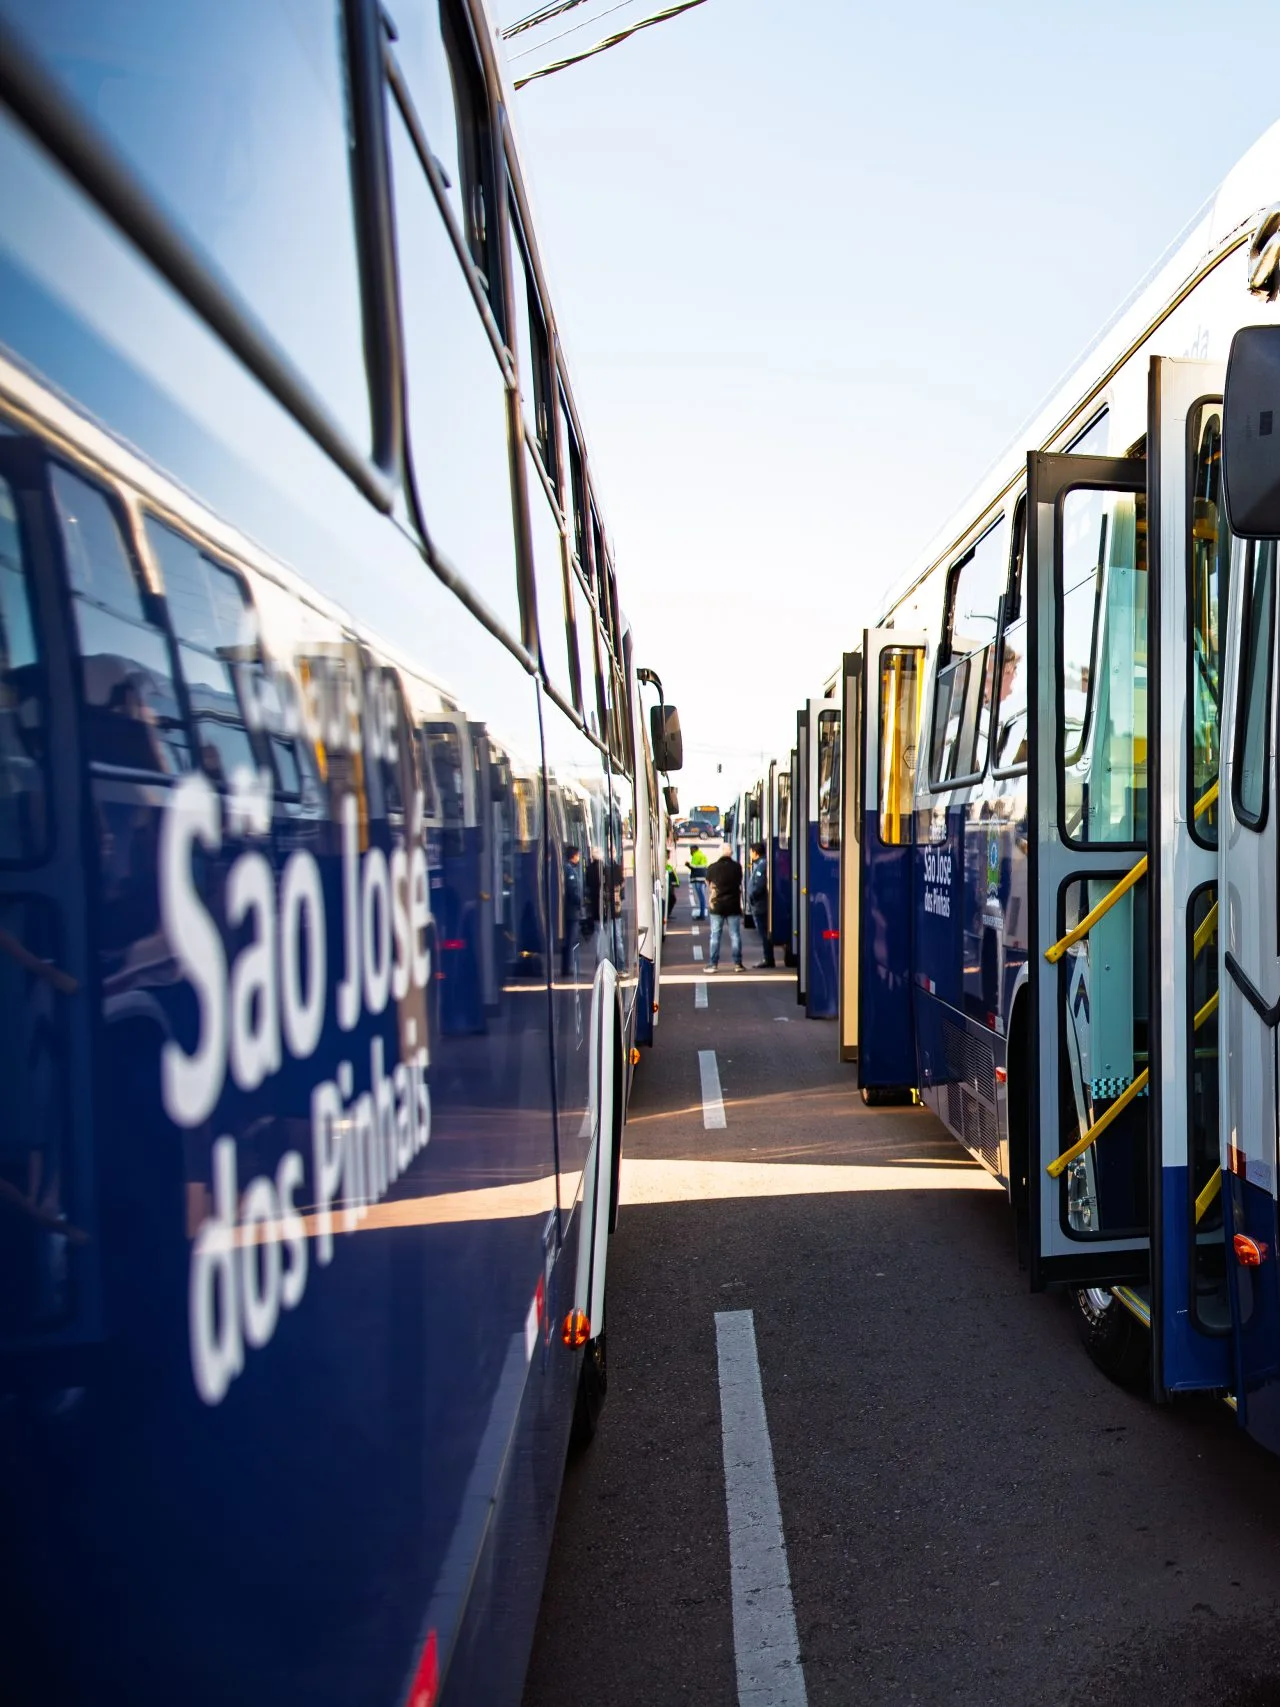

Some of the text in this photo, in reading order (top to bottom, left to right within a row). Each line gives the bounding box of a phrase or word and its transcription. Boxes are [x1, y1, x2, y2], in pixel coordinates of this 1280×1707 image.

[161, 768, 432, 1128] São José
[189, 1022, 432, 1404] dos Pinhais
